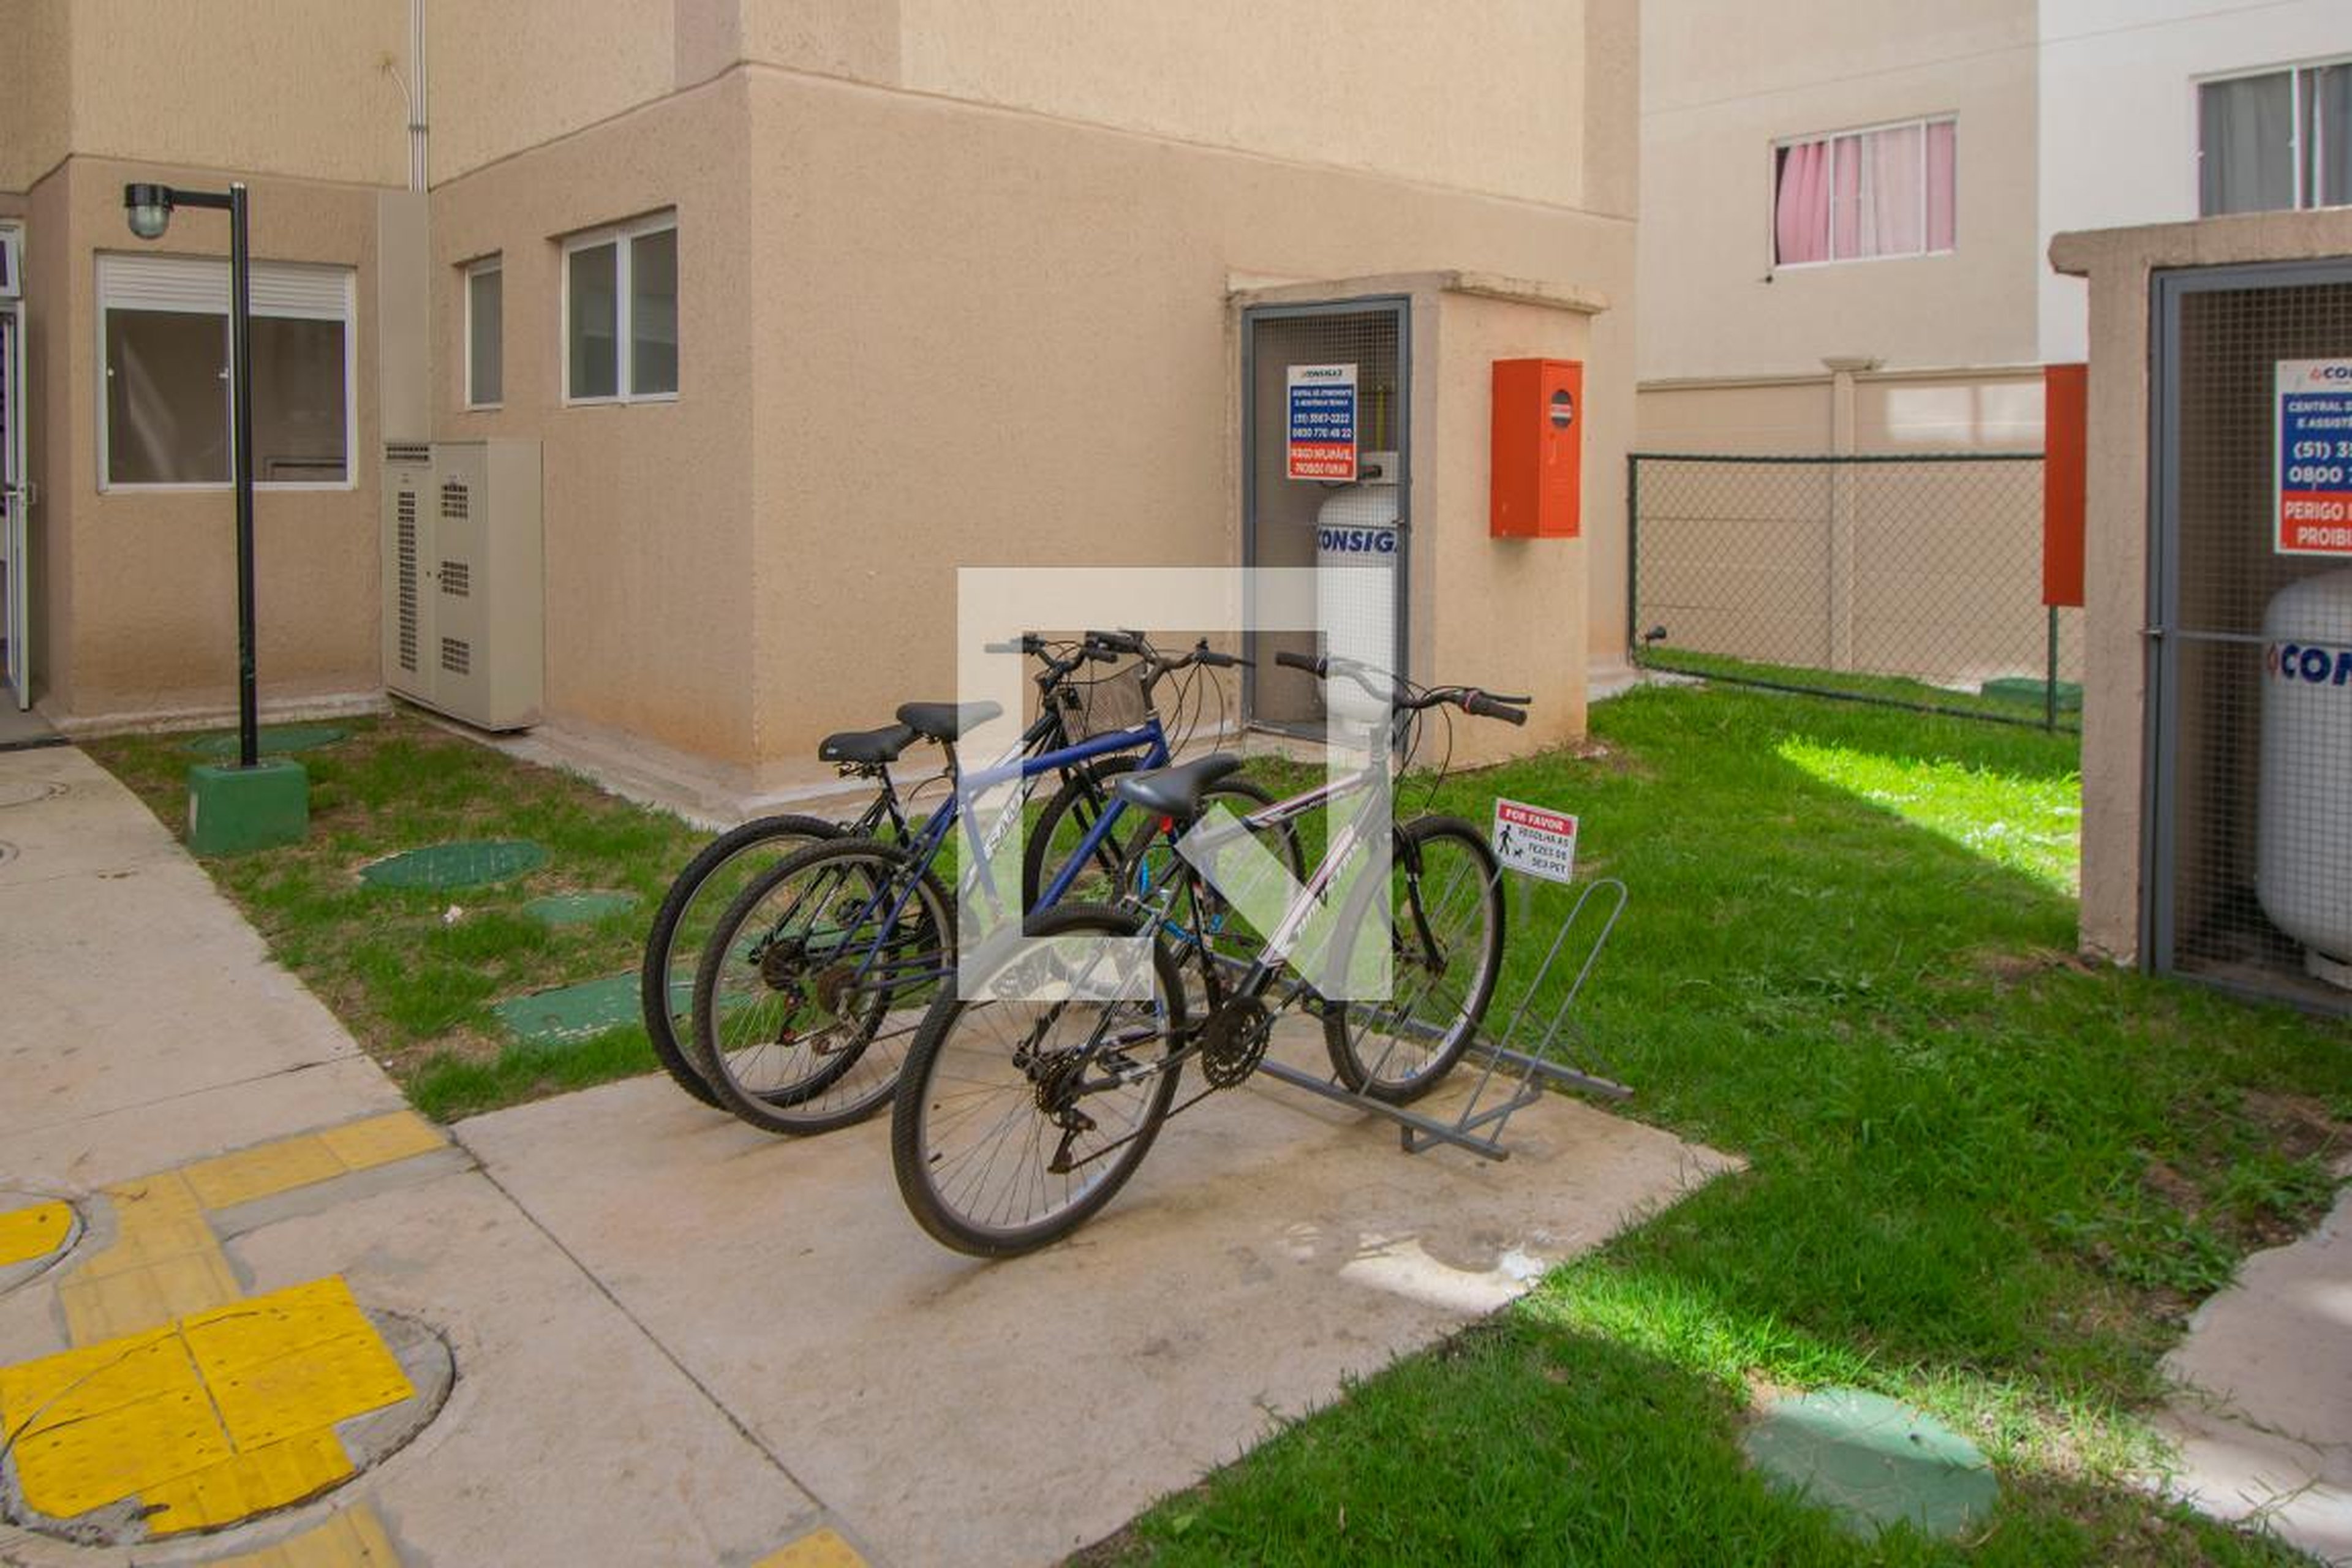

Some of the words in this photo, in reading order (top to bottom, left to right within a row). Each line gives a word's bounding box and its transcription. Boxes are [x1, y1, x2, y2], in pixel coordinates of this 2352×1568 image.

[2294, 441, 2331, 459] (51)
[2290, 466, 2343, 483] 0800
[2285, 501, 2344, 520] PERIGO
[1317, 528, 1397, 553] ONSIG
